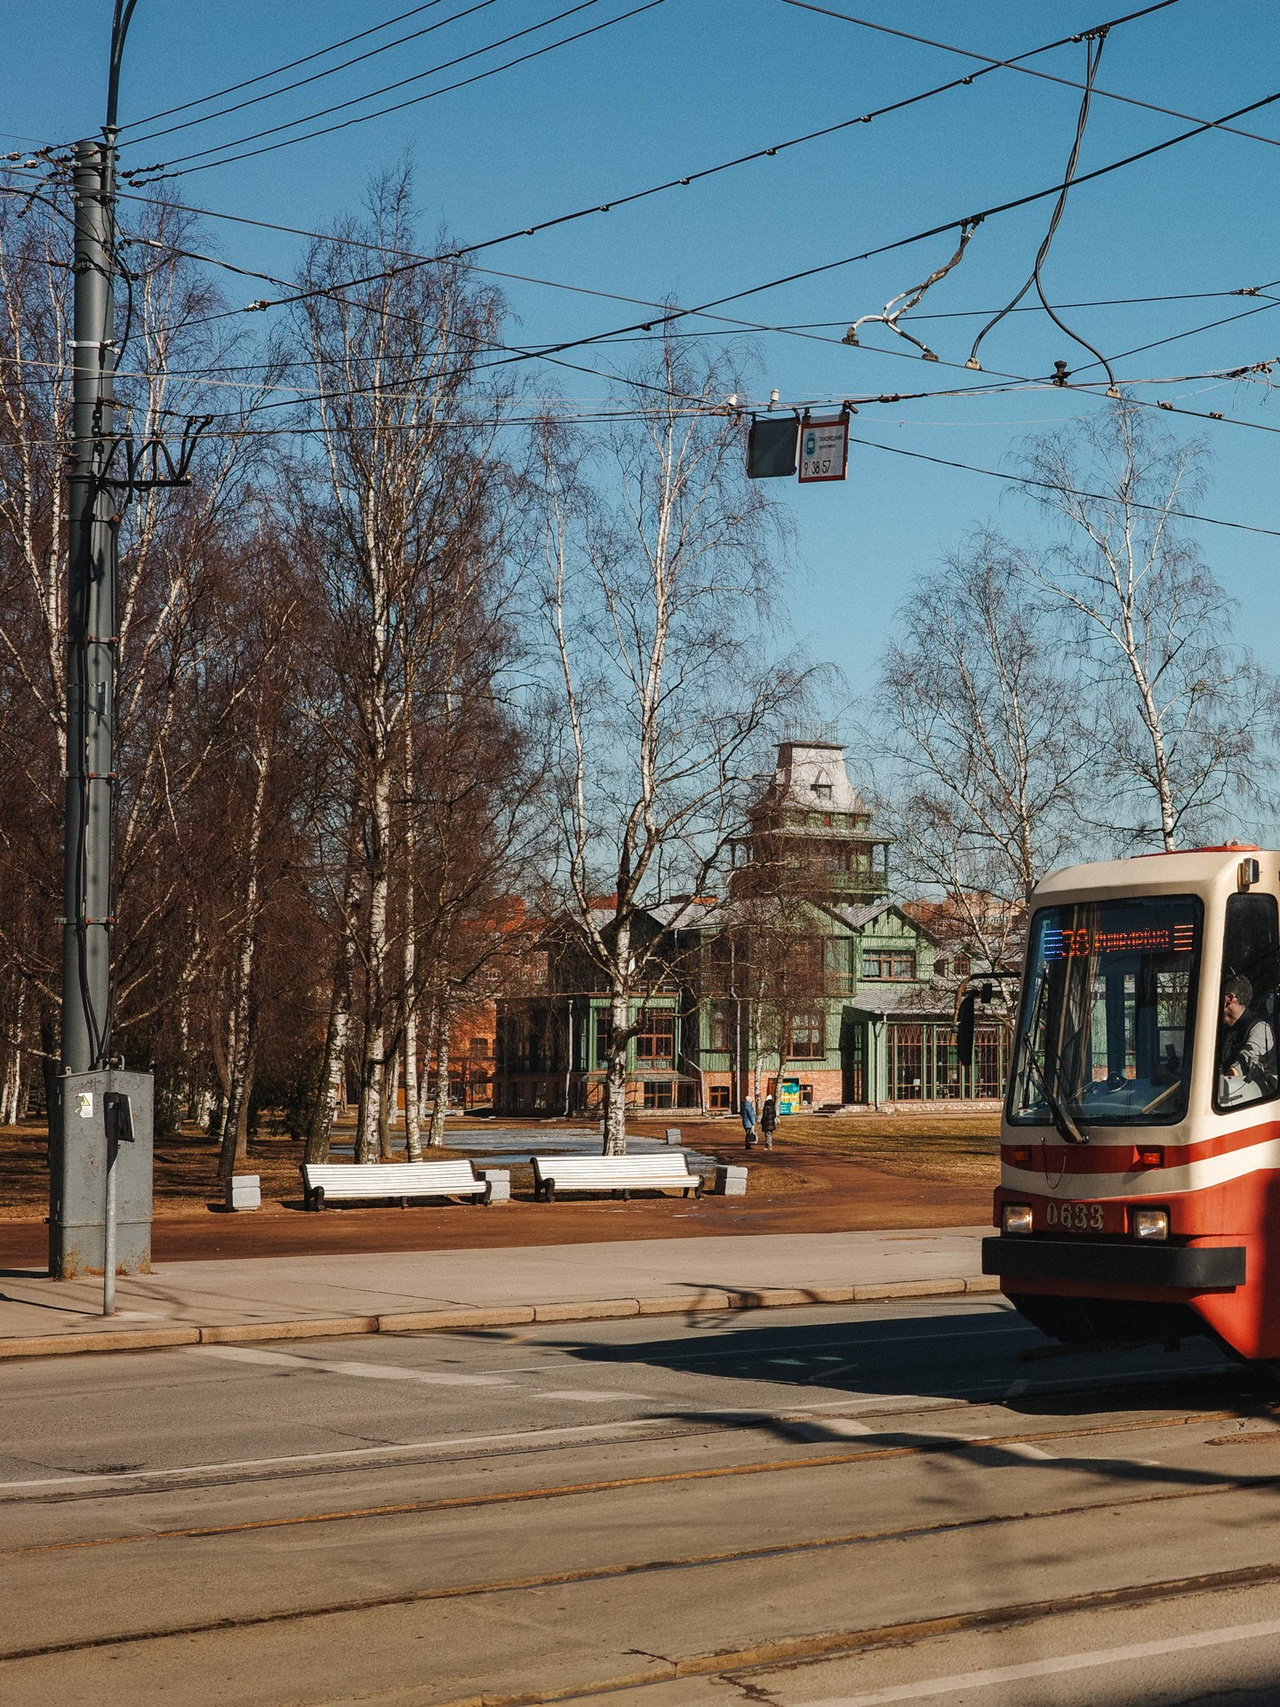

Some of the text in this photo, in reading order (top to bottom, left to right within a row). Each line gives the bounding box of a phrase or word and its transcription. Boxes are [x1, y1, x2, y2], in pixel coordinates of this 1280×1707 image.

[804, 459, 832, 476] 9 38 57
[1062, 928, 1089, 957] 38
[1046, 1202, 1104, 1229] 0633
